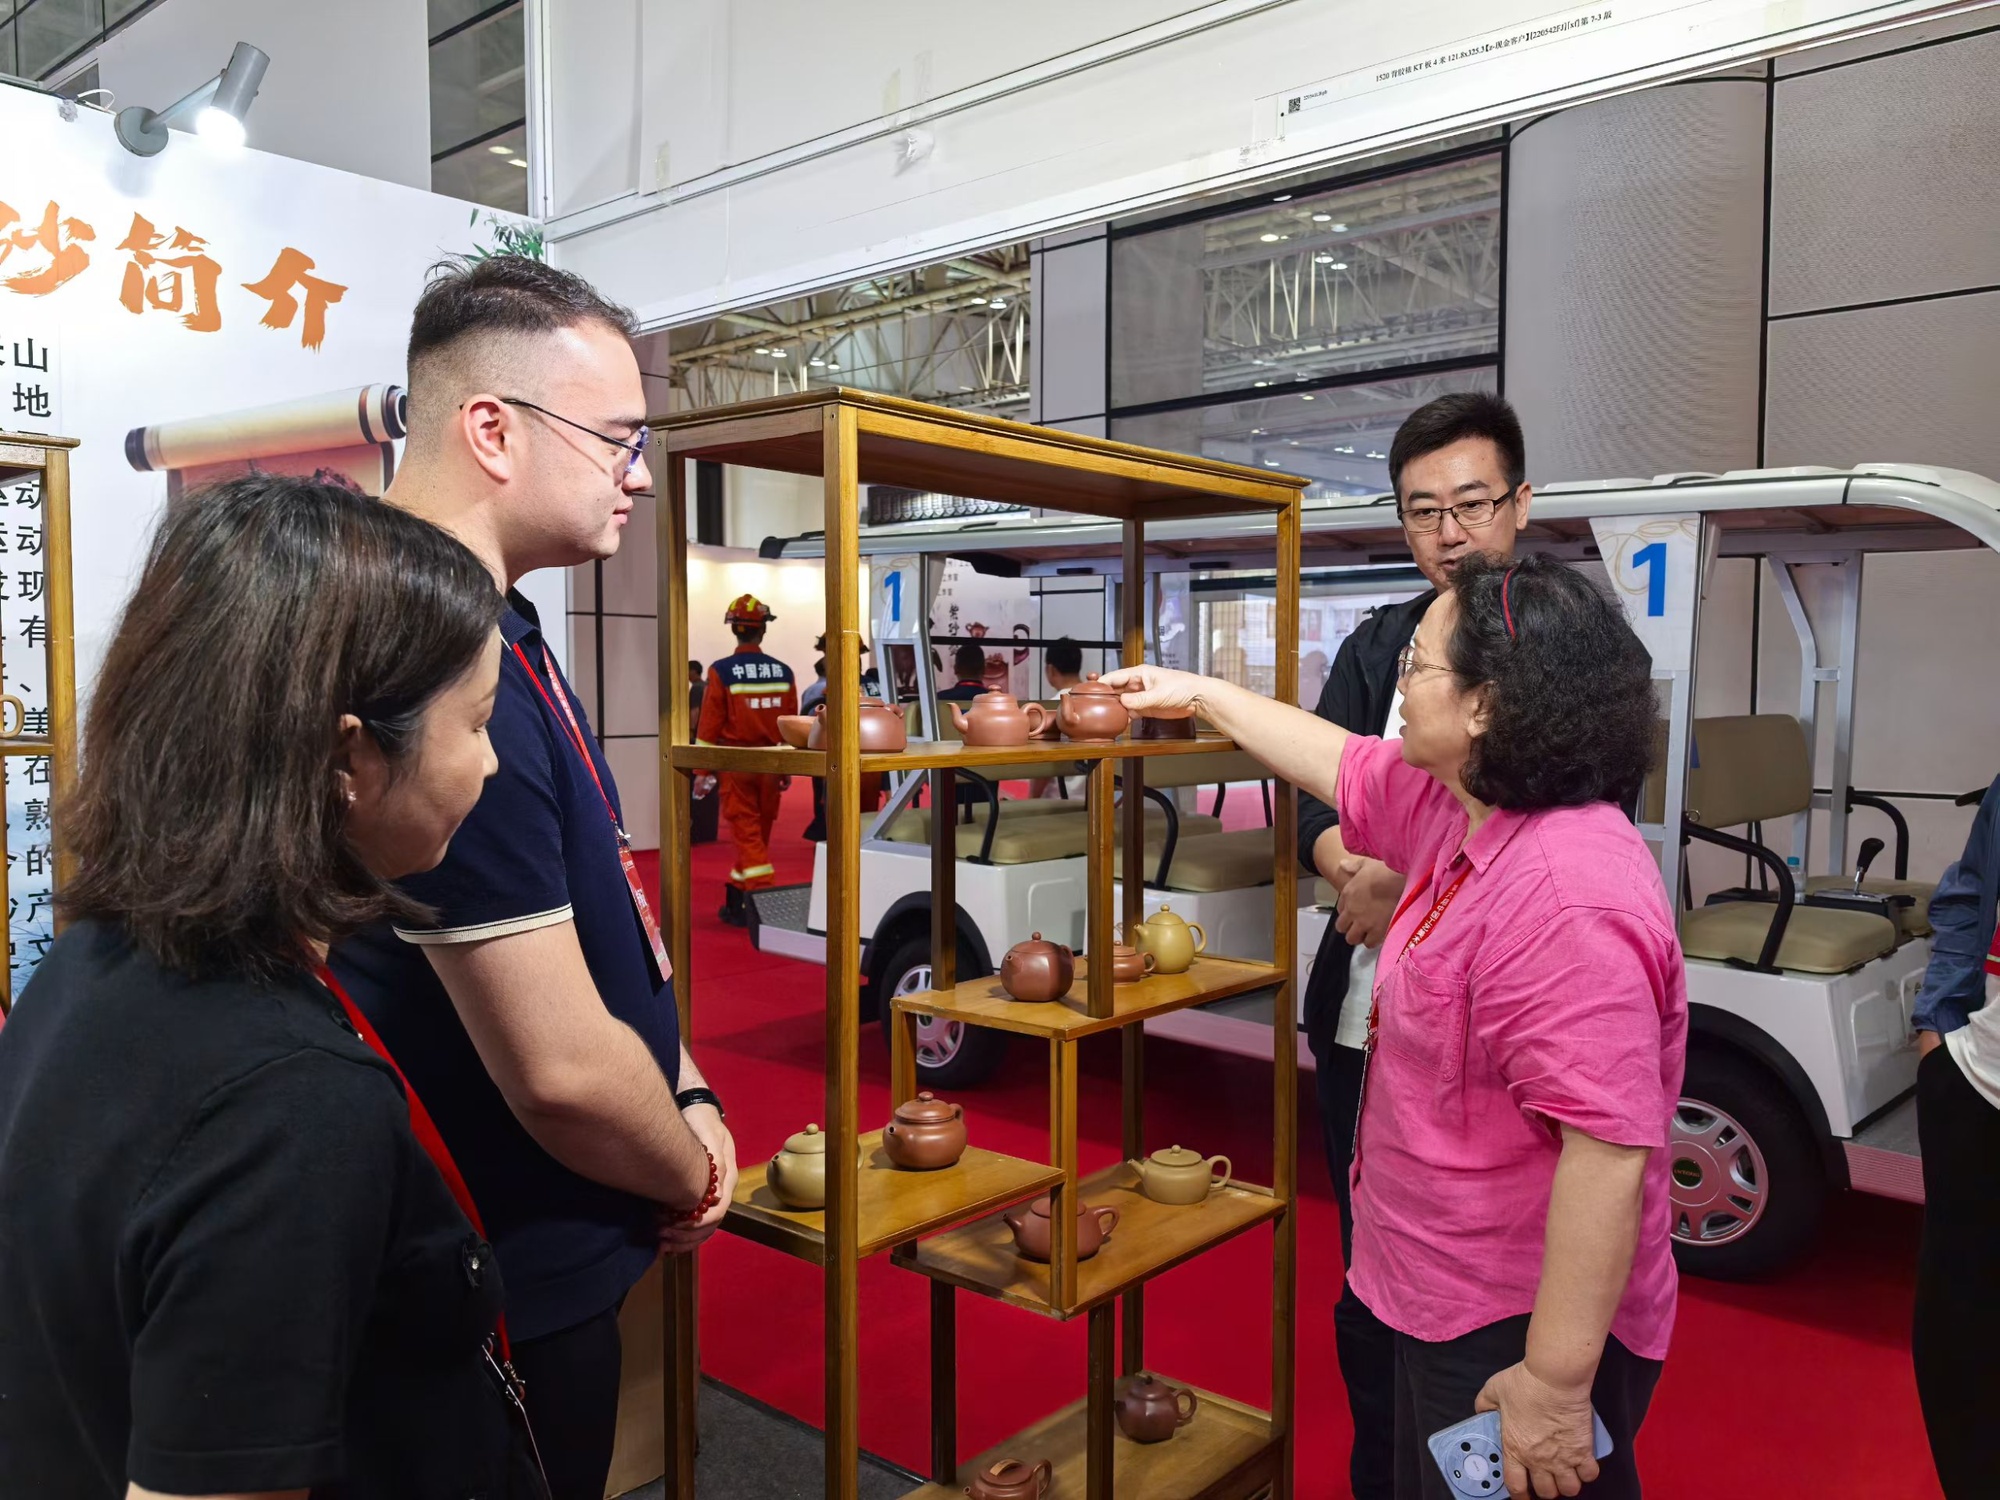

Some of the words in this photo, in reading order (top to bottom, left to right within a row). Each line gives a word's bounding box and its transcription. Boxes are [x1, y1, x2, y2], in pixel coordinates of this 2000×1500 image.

[1375, 72, 1390, 82] 1520
[0, 338, 48, 372] 山
[13, 382, 51, 418] 地
[0, 523, 43, 556] 动
[0, 570, 45, 602] 现
[1632, 542, 1667, 617] 1
[884, 571, 901, 622] 1
[732, 663, 784, 679] 中国消防
